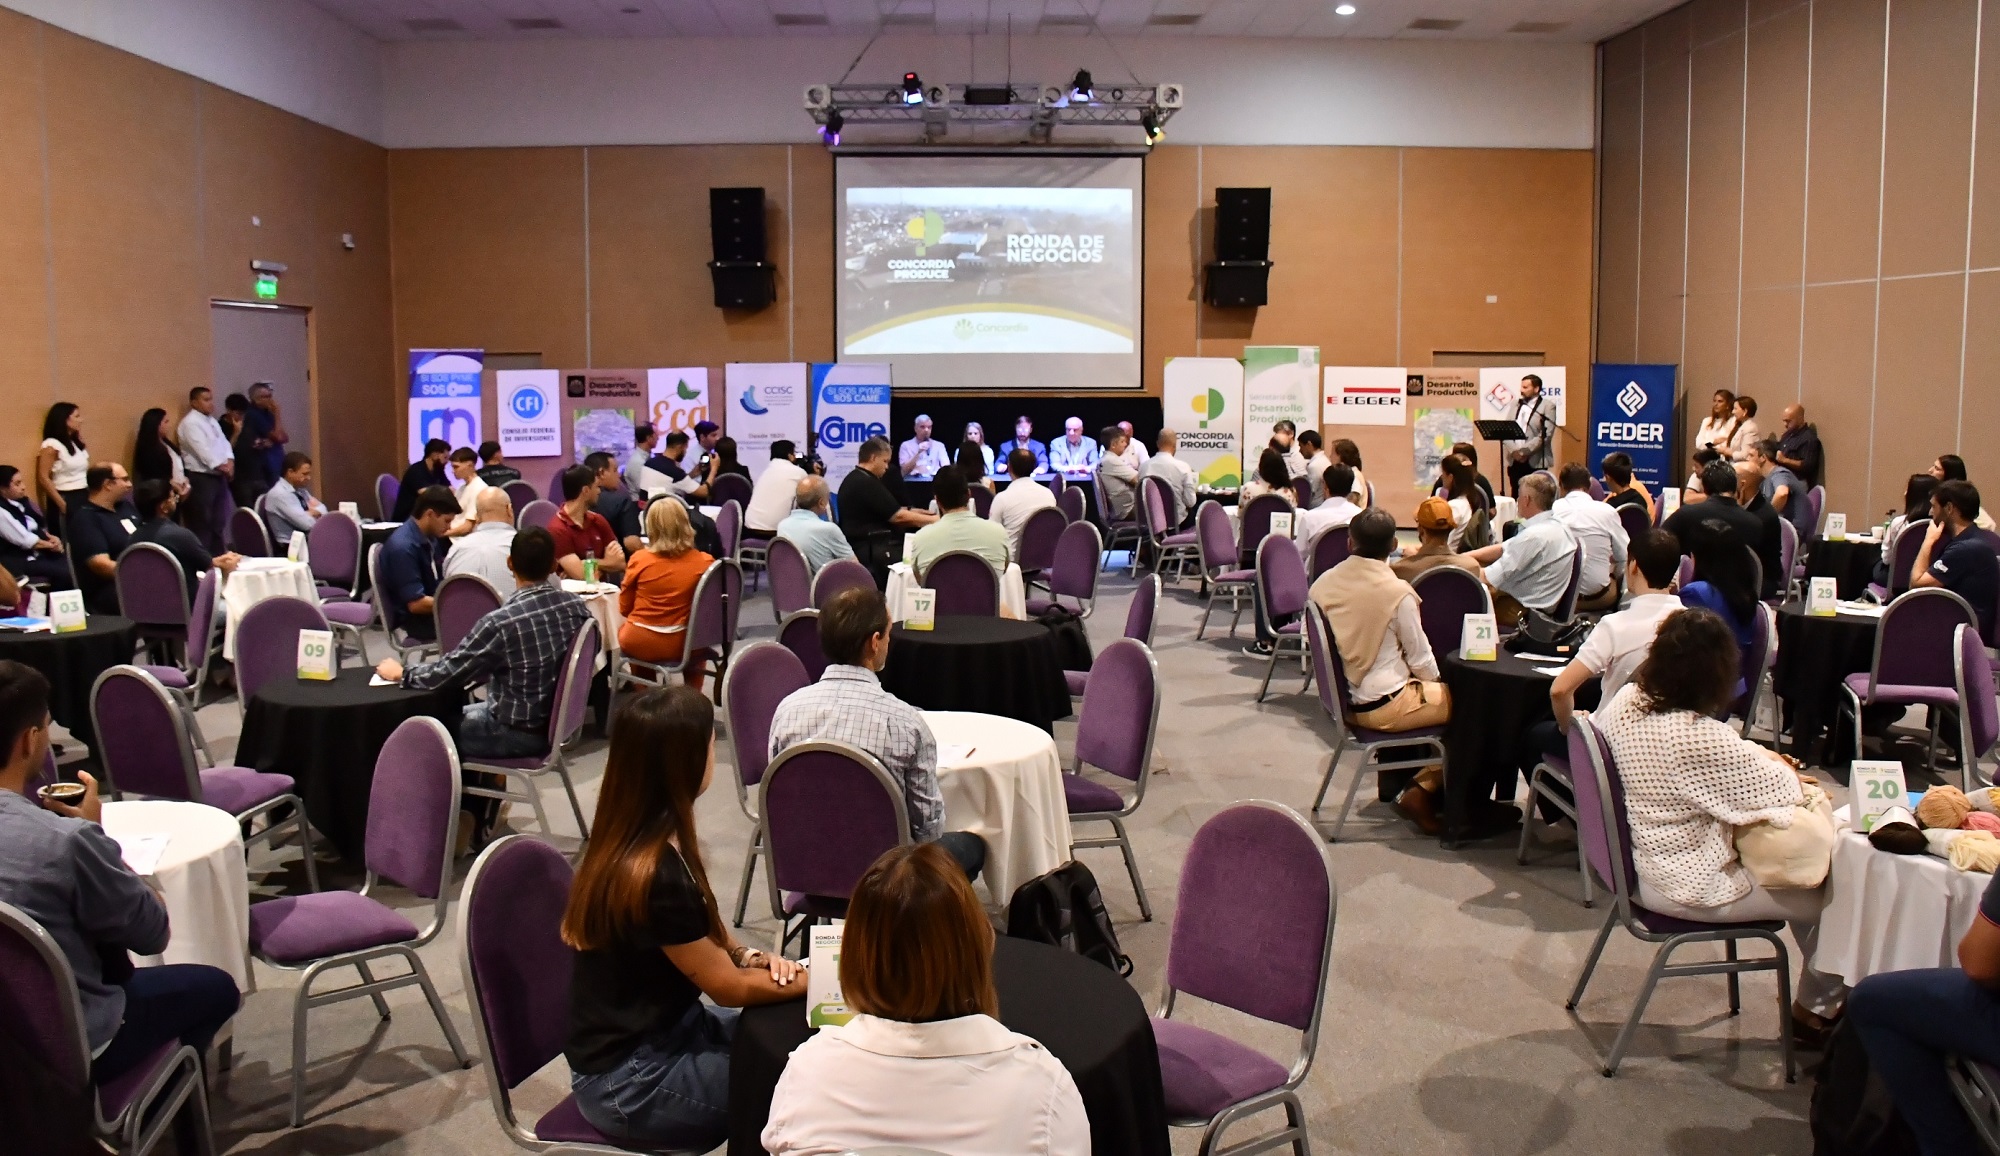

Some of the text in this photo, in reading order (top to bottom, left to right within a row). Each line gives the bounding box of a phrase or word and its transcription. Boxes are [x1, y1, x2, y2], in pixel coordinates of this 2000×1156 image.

[1007, 234, 1104, 248] RONDA DE
[1007, 248, 1103, 262] NEGOCIOS
[888, 259, 955, 269] CONCORDIA
[894, 270, 949, 279] PRODUCE
[422, 384, 446, 395] SOS
[764, 386, 792, 394] CCISC
[516, 396, 539, 411] CFI
[1343, 396, 1401, 405] EGGER
[1249, 404, 1303, 412] Desarrollo
[1176, 432, 1234, 440] CONCORDIA
[1597, 422, 1664, 442] FEDER
[1180, 441, 1228, 449] PRODUCE
[1276, 520, 1288, 528] 23
[1833, 521, 1844, 529] 37
[1818, 588, 1833, 598] 29
[60, 602, 79, 613] 03
[915, 600, 930, 611] 17
[1476, 627, 1491, 639] 21
[304, 644, 325, 657] 09
[1865, 780, 1900, 799] 20
